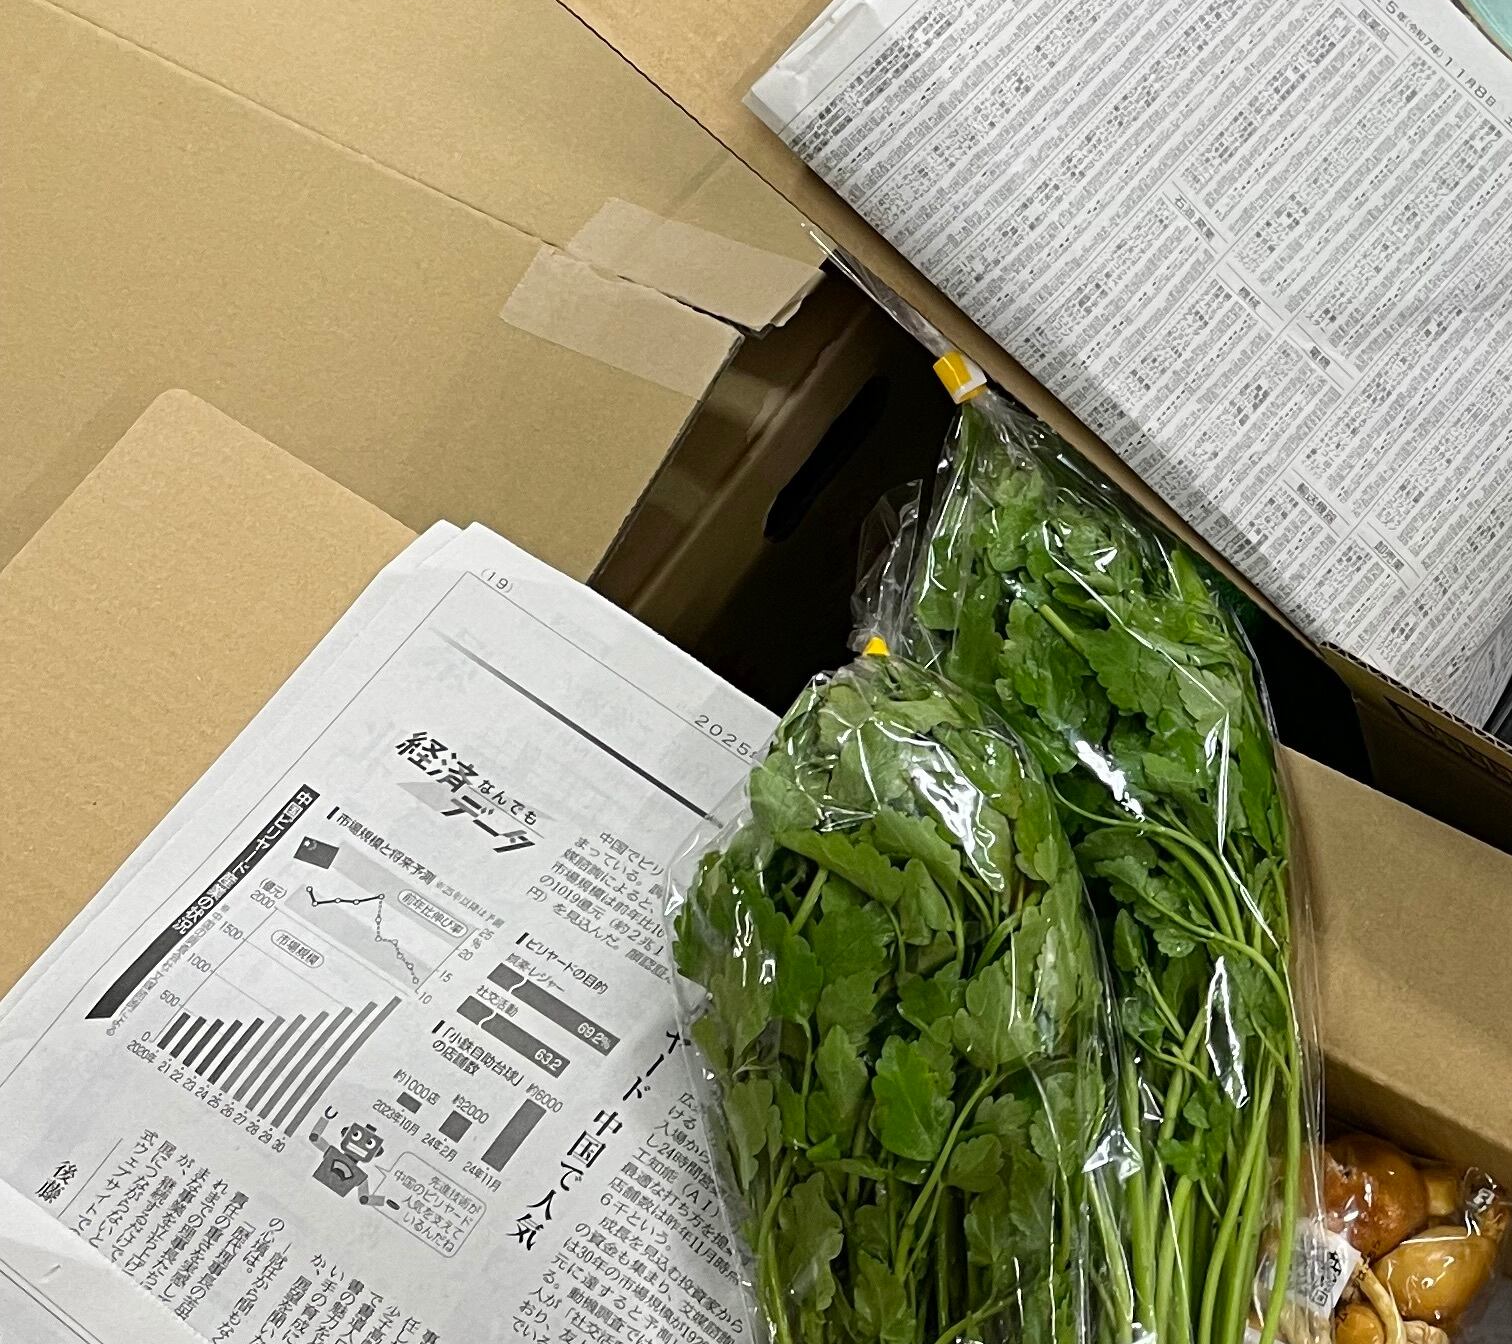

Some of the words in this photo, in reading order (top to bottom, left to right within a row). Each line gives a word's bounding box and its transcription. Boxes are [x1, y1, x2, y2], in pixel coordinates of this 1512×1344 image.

[393, 725, 479, 796] 経済
[477, 778, 539, 827] なんでも
[441, 790, 535, 864] データ
[336, 813, 435, 885] 市場規模と将来予測
[249, 889, 274, 911] 2000
[218, 920, 243, 941] 1500
[478, 927, 493, 941] 25
[186, 952, 210, 973] 1000
[457, 947, 472, 962] 20
[525, 936, 608, 995] ビリヤードの目的
[437, 969, 452, 983] 15
[158, 988, 180, 1008] 500
[417, 991, 431, 1005] 10
[475, 983, 519, 1018] 社交活動
[534, 1047, 562, 1071] 63.2
[392, 1069, 440, 1106] 約1000店
[524, 1083, 563, 1114] 約6000
[157, 1061, 170, 1075] 21
[169, 1069, 183, 1083] 22
[181, 1078, 195, 1092] 23
[194, 1087, 208, 1101] 24
[207, 1095, 221, 1109] 25
[219, 1104, 233, 1118] 26
[232, 1112, 246, 1127] 27
[245, 1121, 259, 1135] 28
[258, 1130, 272, 1144] 29
[271, 1139, 285, 1153] 30
[371, 1099, 420, 1136] 2023年10月
[451, 1094, 490, 1124] 約2000
[421, 1131, 458, 1162] 24年2月
[461, 1159, 502, 1192] 24年11月
[392, 1168, 474, 1228] 中国のビリヤード
[401, 1211, 456, 1253] いるんだね
